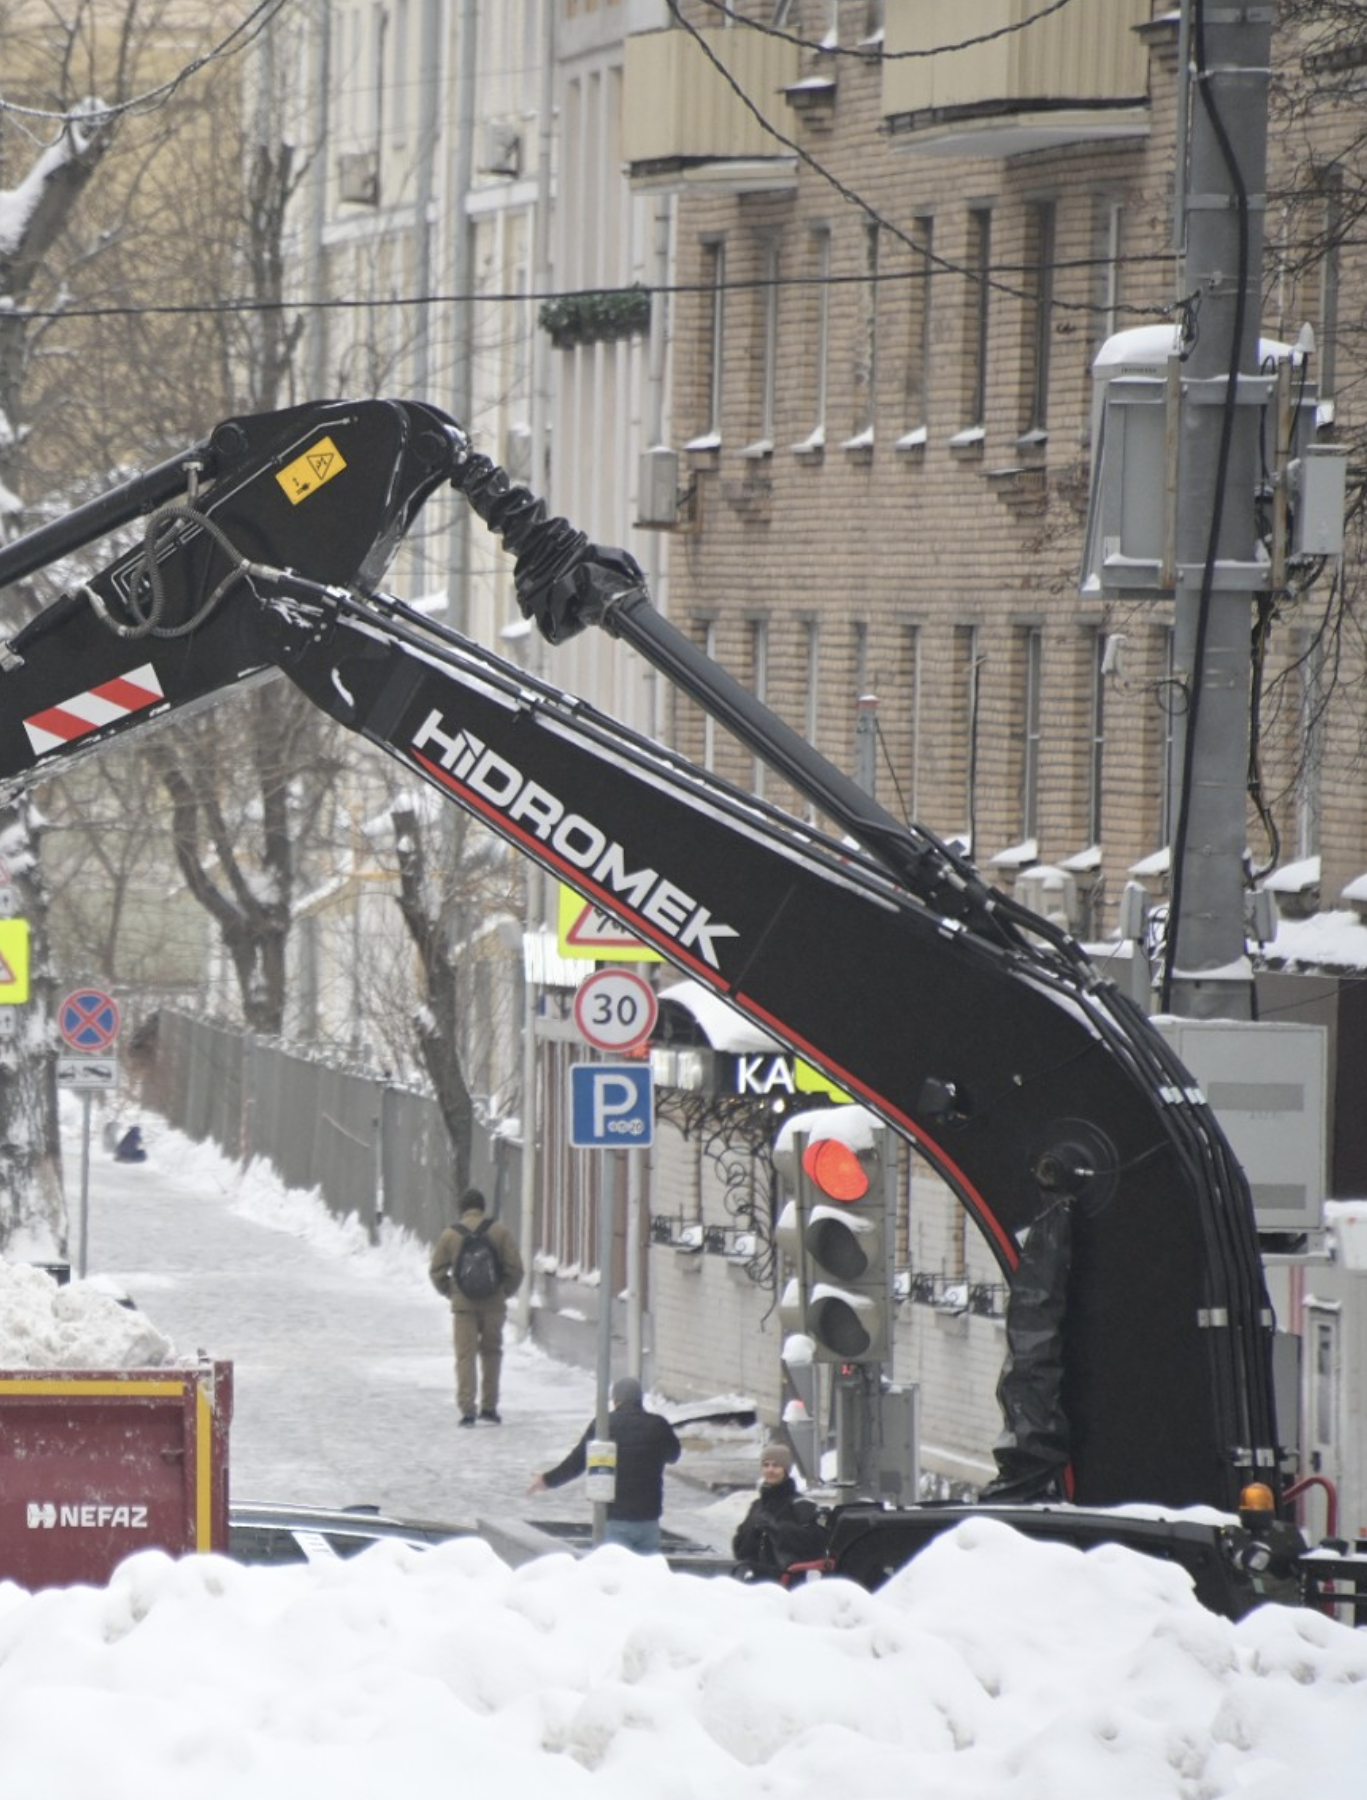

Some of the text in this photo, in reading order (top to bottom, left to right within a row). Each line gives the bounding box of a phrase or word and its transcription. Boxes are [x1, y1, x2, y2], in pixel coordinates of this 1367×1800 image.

[592, 993, 637, 1026] 30
[594, 1074, 637, 1137] P
[60, 1505, 148, 1528] NEFAZ
